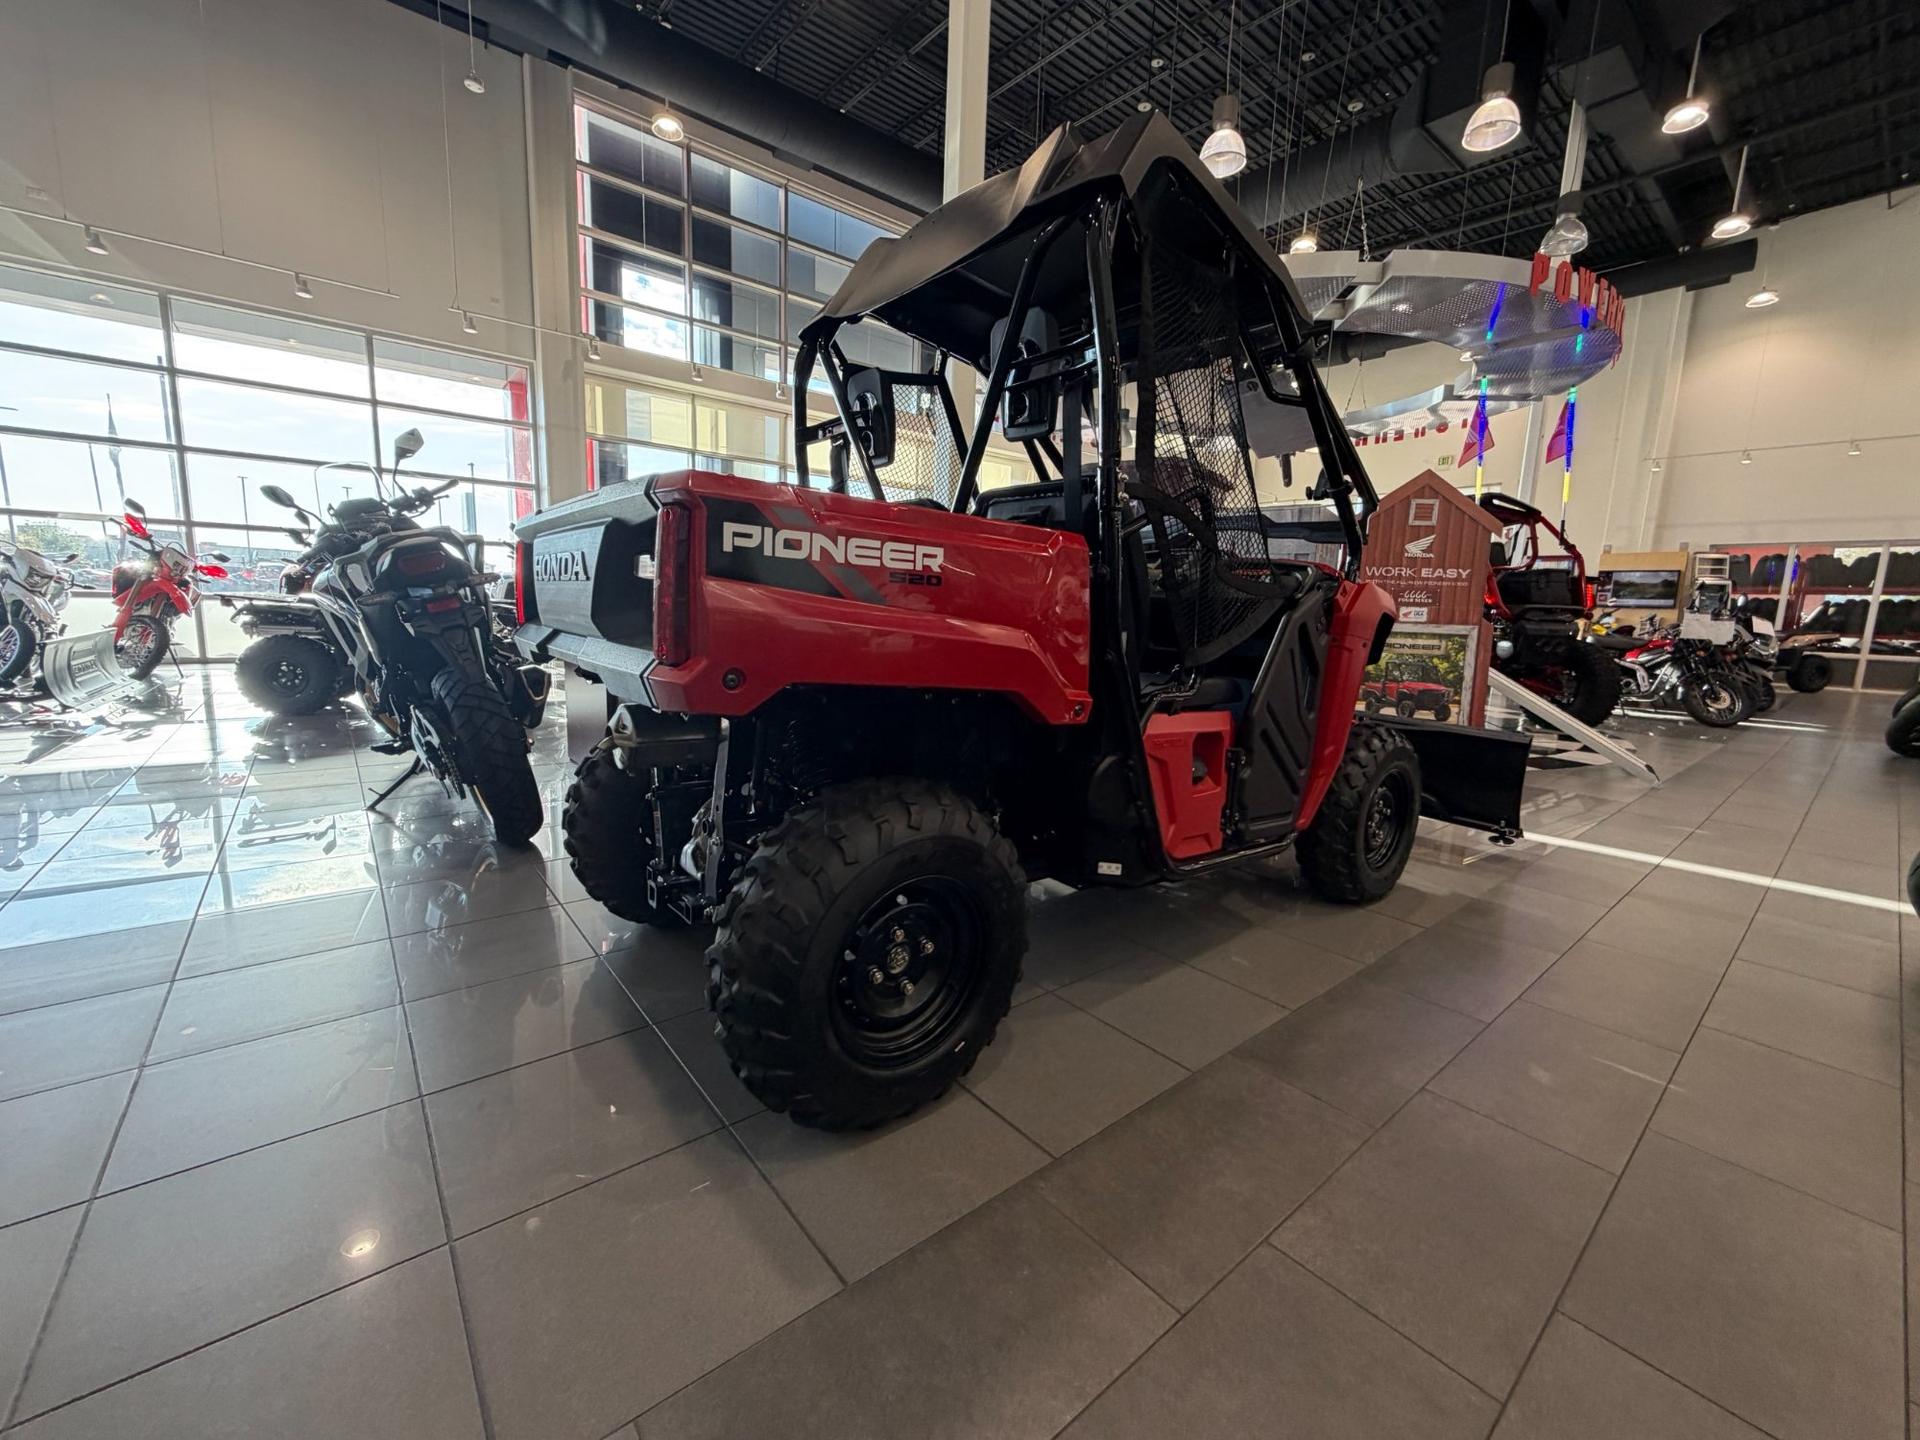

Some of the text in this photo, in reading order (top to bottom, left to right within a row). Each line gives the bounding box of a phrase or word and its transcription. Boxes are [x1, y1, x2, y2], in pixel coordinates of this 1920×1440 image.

[722, 521, 945, 573] PIONEER
[535, 550, 589, 581] HONDA
[1365, 566, 1471, 578] WORK EASY
[888, 571, 943, 587] 520
